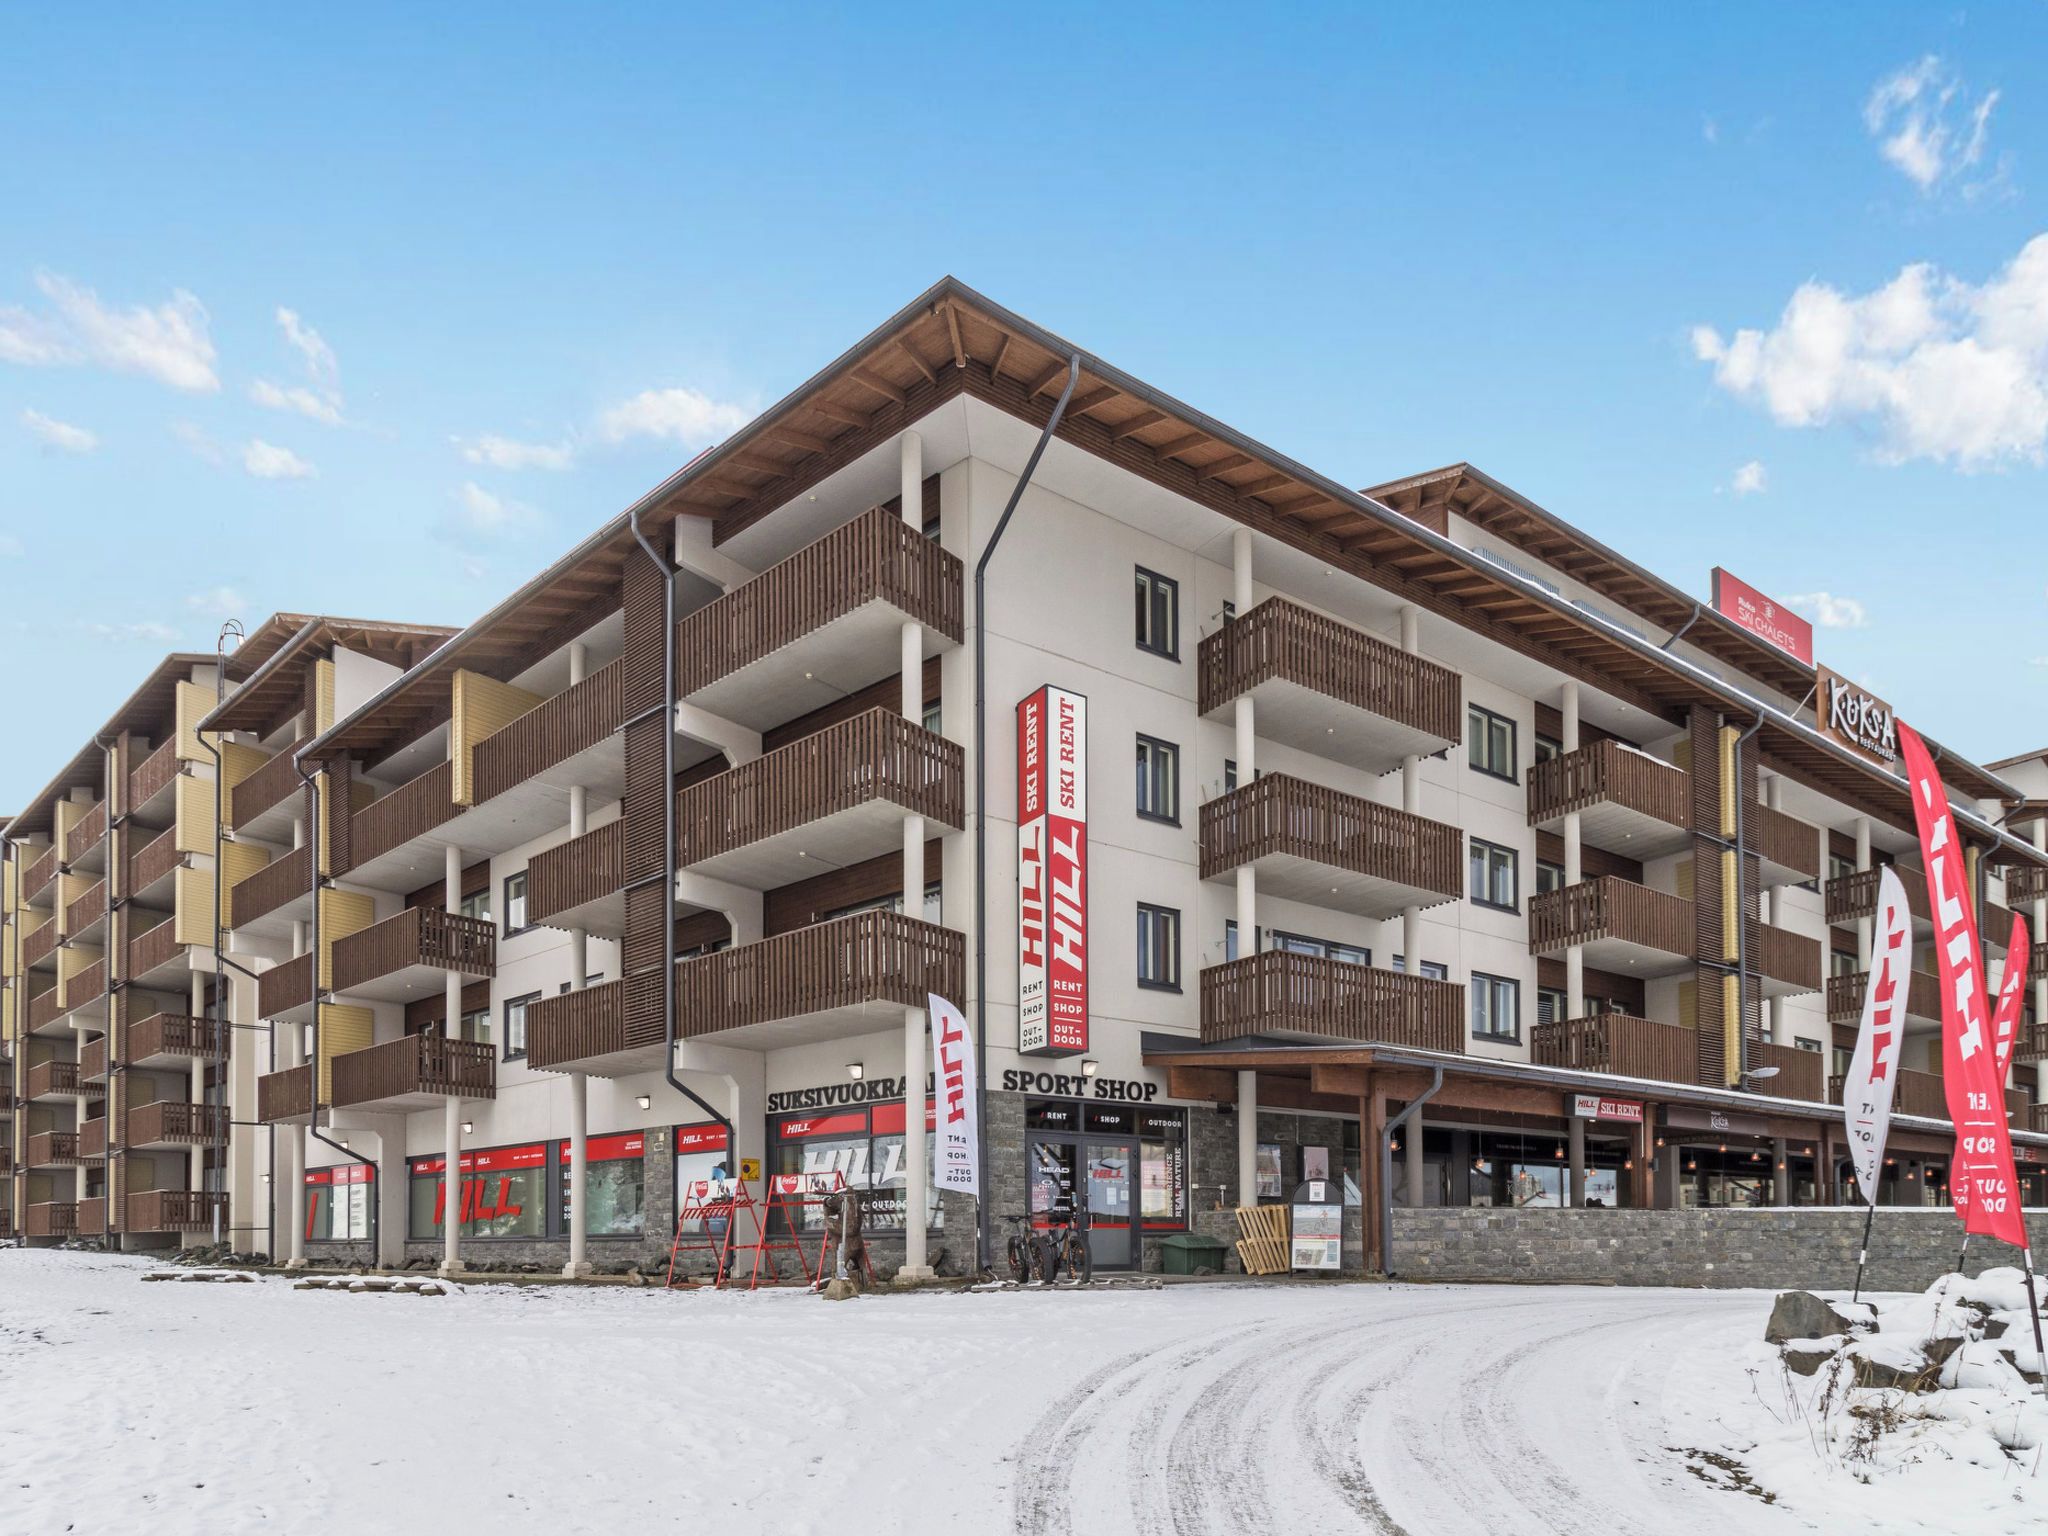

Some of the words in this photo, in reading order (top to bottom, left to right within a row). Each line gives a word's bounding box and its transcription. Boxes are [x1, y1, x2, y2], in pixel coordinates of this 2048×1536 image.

[1738, 606, 1753, 626] SKI
[1755, 616, 1795, 650] CHALETS
[1026, 702, 1038, 769] RENT
[1060, 696, 1075, 765] RENT
[1860, 736, 1896, 762] RESTAURANT
[1026, 770, 1038, 813] SKI
[1060, 767, 1075, 809] SKI
[1022, 825, 1043, 969] HILL
[1053, 826, 1083, 972] HILL
[1023, 980, 1043, 995] RENT
[1053, 979, 1083, 993] RENT
[1023, 1003, 1043, 1017] SHOP
[1053, 1002, 1083, 1015] SHOP
[1053, 1024, 1081, 1035] OUT-
[1023, 1035, 1043, 1047] DOOR
[1053, 1035, 1083, 1046] DOOR
[768, 1071, 936, 1112] SUKSIVUOKRA
[1003, 1069, 1087, 1097] SPORT
[1094, 1078, 1158, 1102] SHOP
[1577, 1099, 1596, 1108] HILL
[1600, 1102, 1616, 1115] SKI
[1616, 1104, 1641, 1117] RENT
[1047, 1111, 1067, 1120] RENT
[1100, 1115, 1120, 1124] SHOP
[786, 1123, 811, 1134] HILL
[1148, 1119, 1182, 1128] OUTDOOR
[682, 1134, 703, 1145] HILL
[417, 1163, 428, 1171] HILL
[477, 1157, 491, 1165] HILL
[803, 1144, 907, 1187] HILL
[1038, 1166, 1070, 1174] HEAD
[1092, 1169, 1125, 1179] HILL
[872, 1200, 907, 1209] OUTDOO
